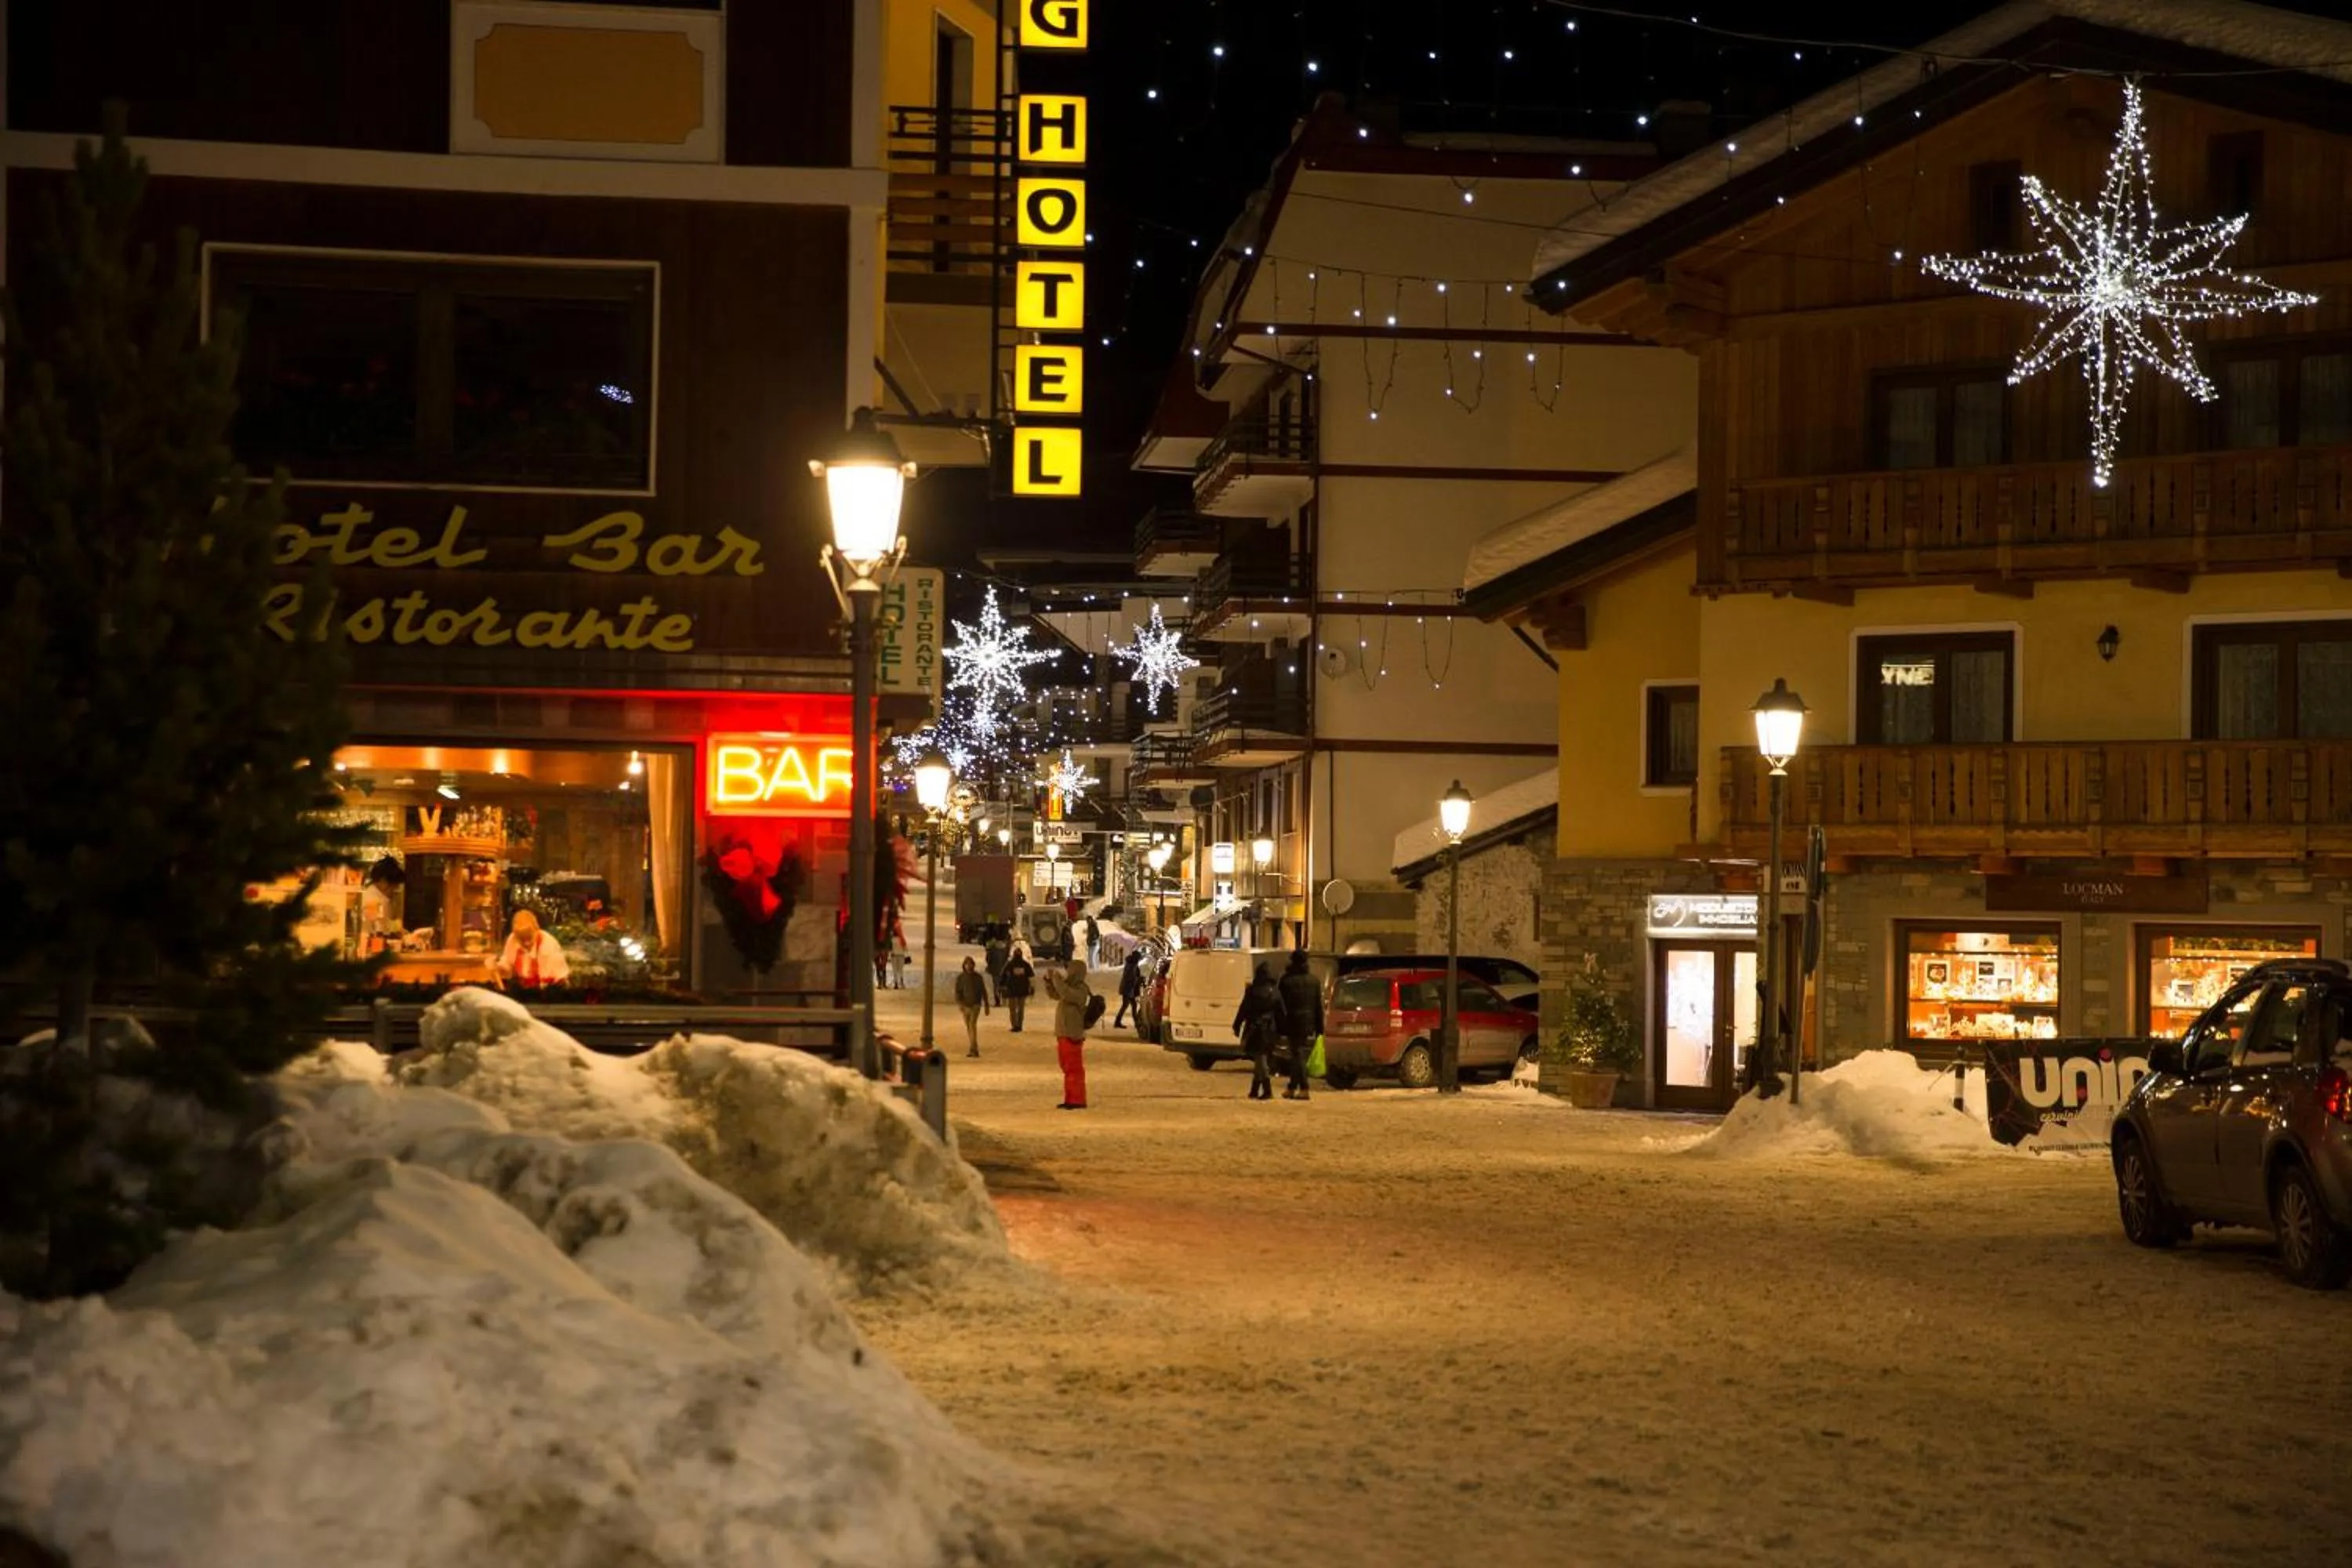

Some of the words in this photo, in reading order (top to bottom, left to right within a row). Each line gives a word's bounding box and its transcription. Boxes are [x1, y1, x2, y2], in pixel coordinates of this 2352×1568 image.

[1029, 0, 1078, 38] G
[1026, 103, 1077, 485] HOTEL
[205, 495, 488, 568] otel
[543, 510, 765, 575] Bar
[879, 583, 905, 685] HOTEL
[916, 579, 933, 686] RISTORANTE
[717, 746, 853, 802] BAR
[2061, 880, 2124, 895] LOCMAN
